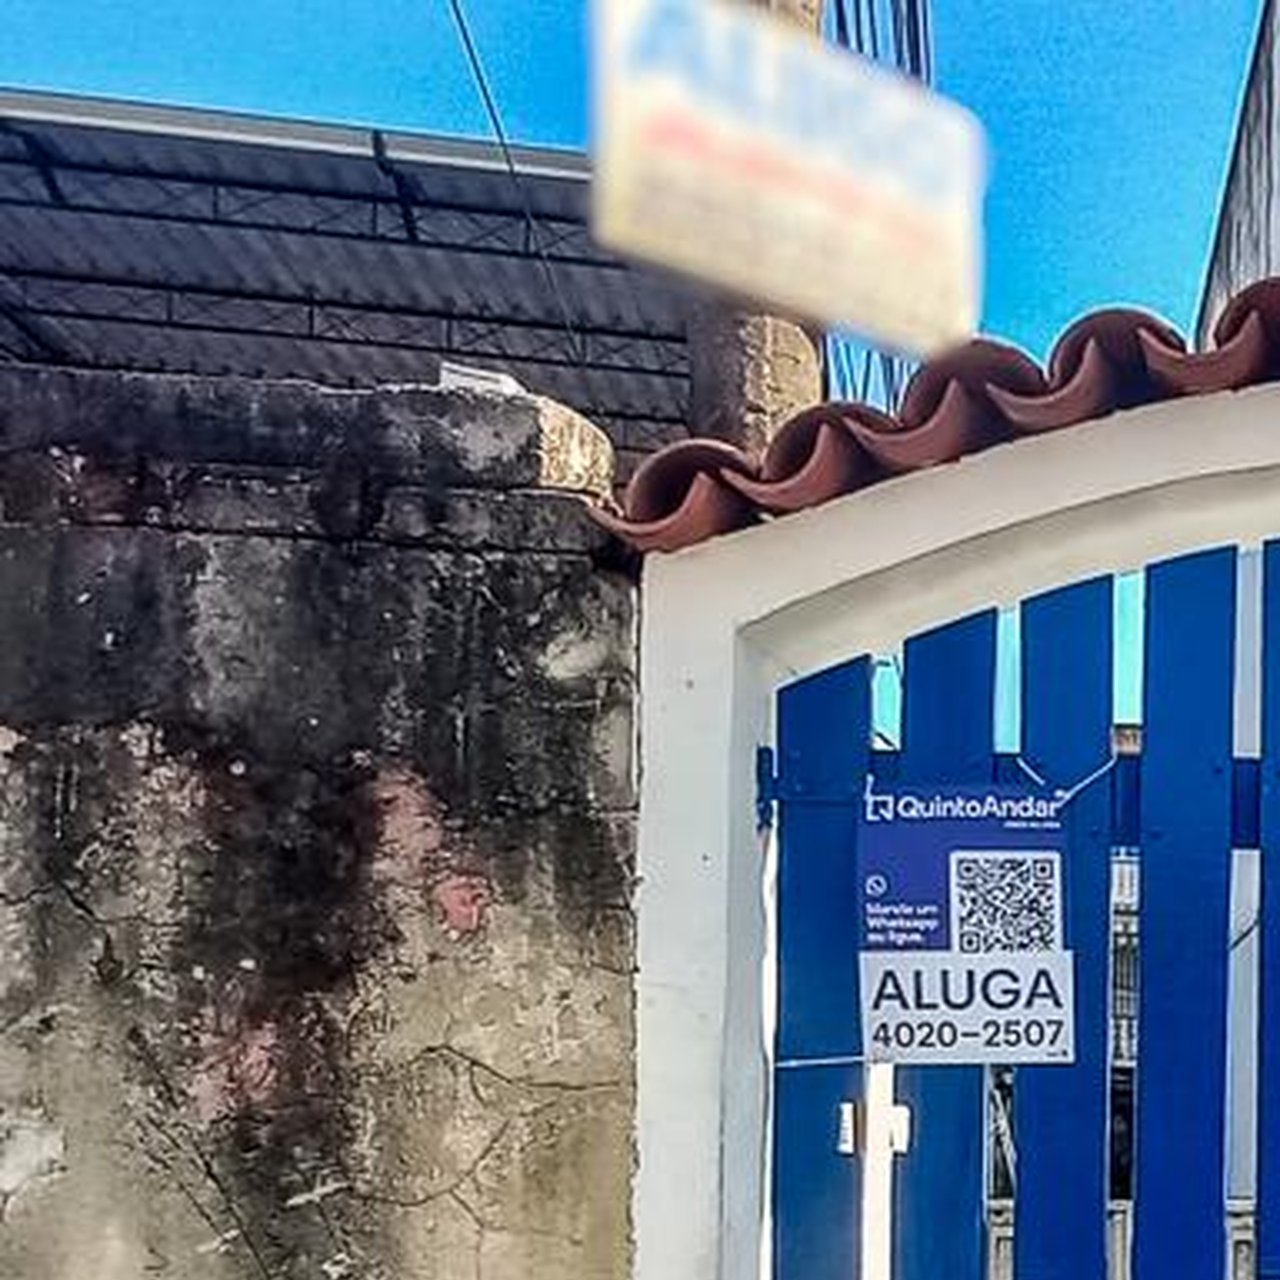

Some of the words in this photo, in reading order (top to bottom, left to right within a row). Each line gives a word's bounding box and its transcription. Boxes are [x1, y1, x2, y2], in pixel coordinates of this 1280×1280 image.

[897, 796, 1060, 821] QuintoAndar
[872, 968, 1064, 1011] ALUGA
[872, 1020, 1065, 1048] 4020-2507
